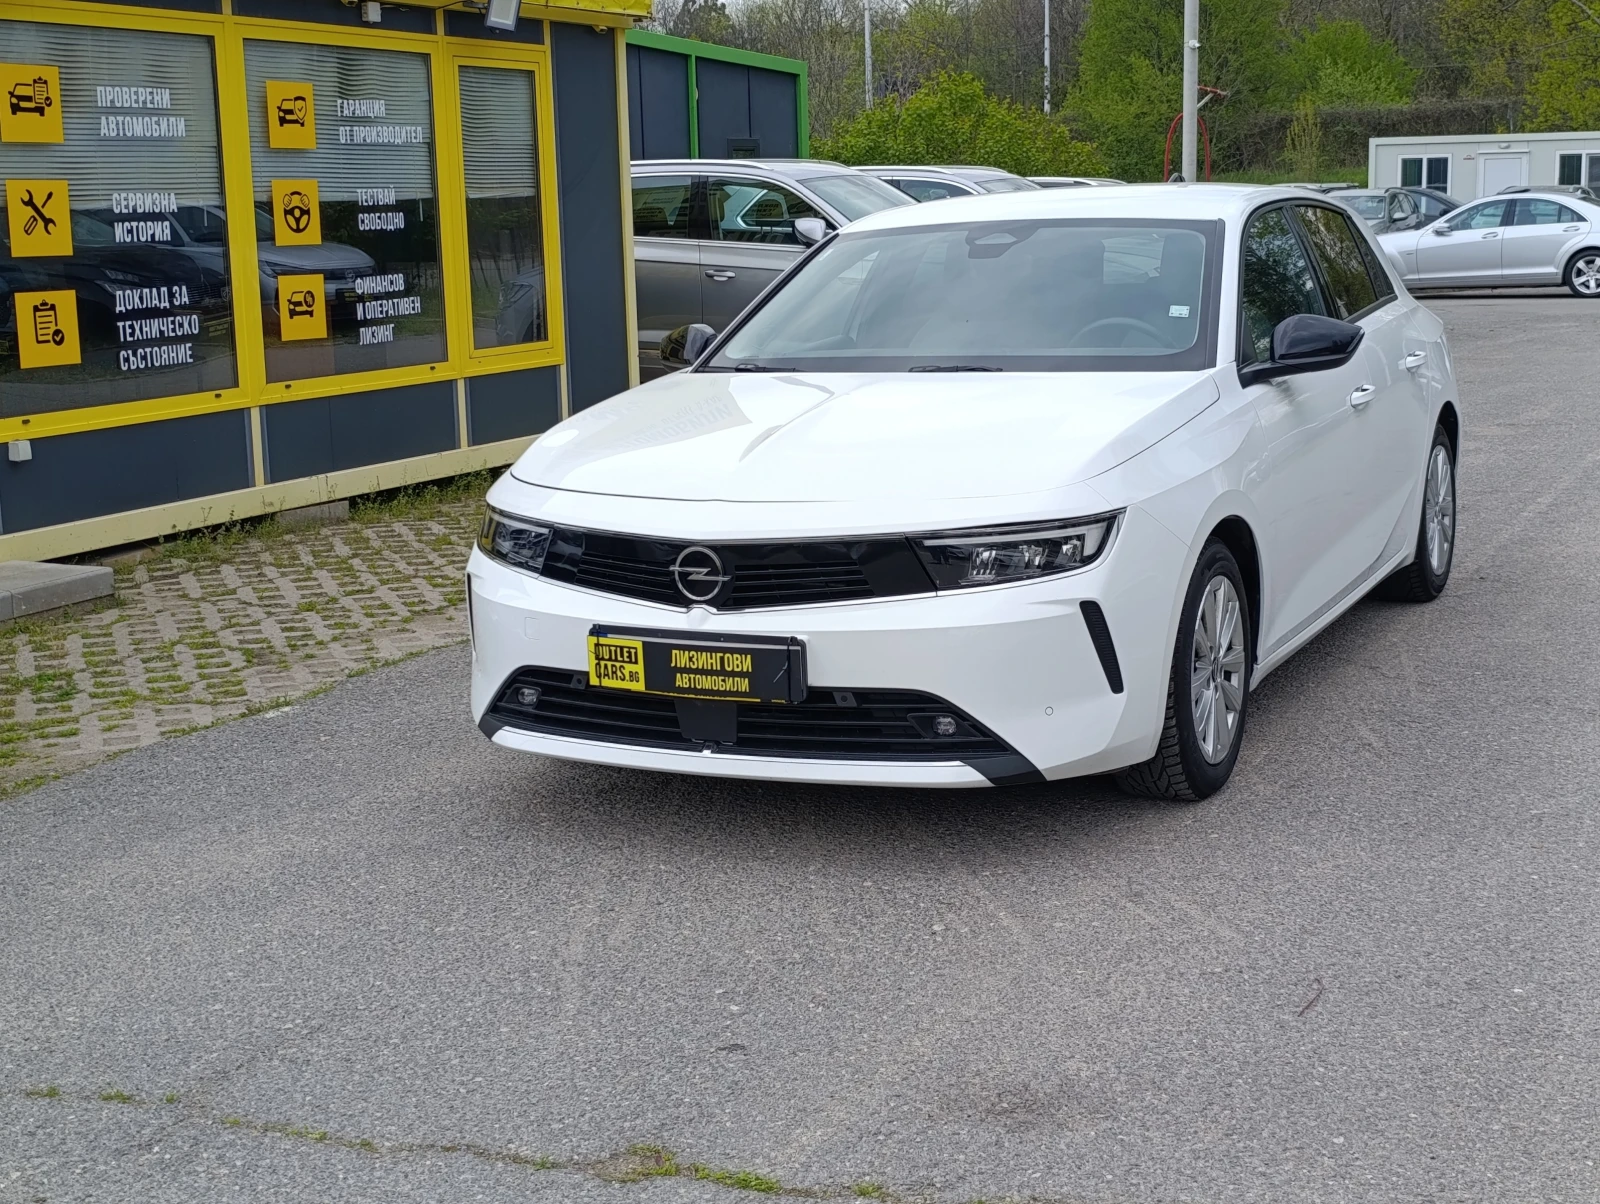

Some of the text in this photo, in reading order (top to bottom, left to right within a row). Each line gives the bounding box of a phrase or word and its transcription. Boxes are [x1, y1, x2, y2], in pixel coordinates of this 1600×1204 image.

[96, 86, 171, 109] ПРОВЕРЕНИ
[336, 99, 386, 118] ГАРАНЦИЯ
[101, 116, 185, 137] АВТОМОБИЛИ
[339, 126, 422, 145] ОТ ПРОИЗВОДИТЕЛ
[112, 192, 178, 214] СЕРВИЗНА
[357, 185, 396, 206] ТЕСТВАЙ
[114, 221, 171, 242] ИСТОРИЯ
[358, 211, 405, 231] СВОБОДНО
[355, 273, 405, 295] ФИНАНСОВ
[115, 285, 189, 314] ДОКЛАД ЗА
[356, 302, 364, 320] И
[365, 296, 421, 319] ОПЕРАТИВЕН
[117, 314, 199, 342] ТЕХНИЧЕСКО
[359, 324, 395, 345] ЛИЗИНГ
[119, 343, 194, 371] СЪСТОЯНИЕ
[595, 645, 636, 662] OUTLET
[670, 649, 752, 672] ЛИЗИНГОВИ
[675, 673, 749, 692] АВТОМОБИЛИ
